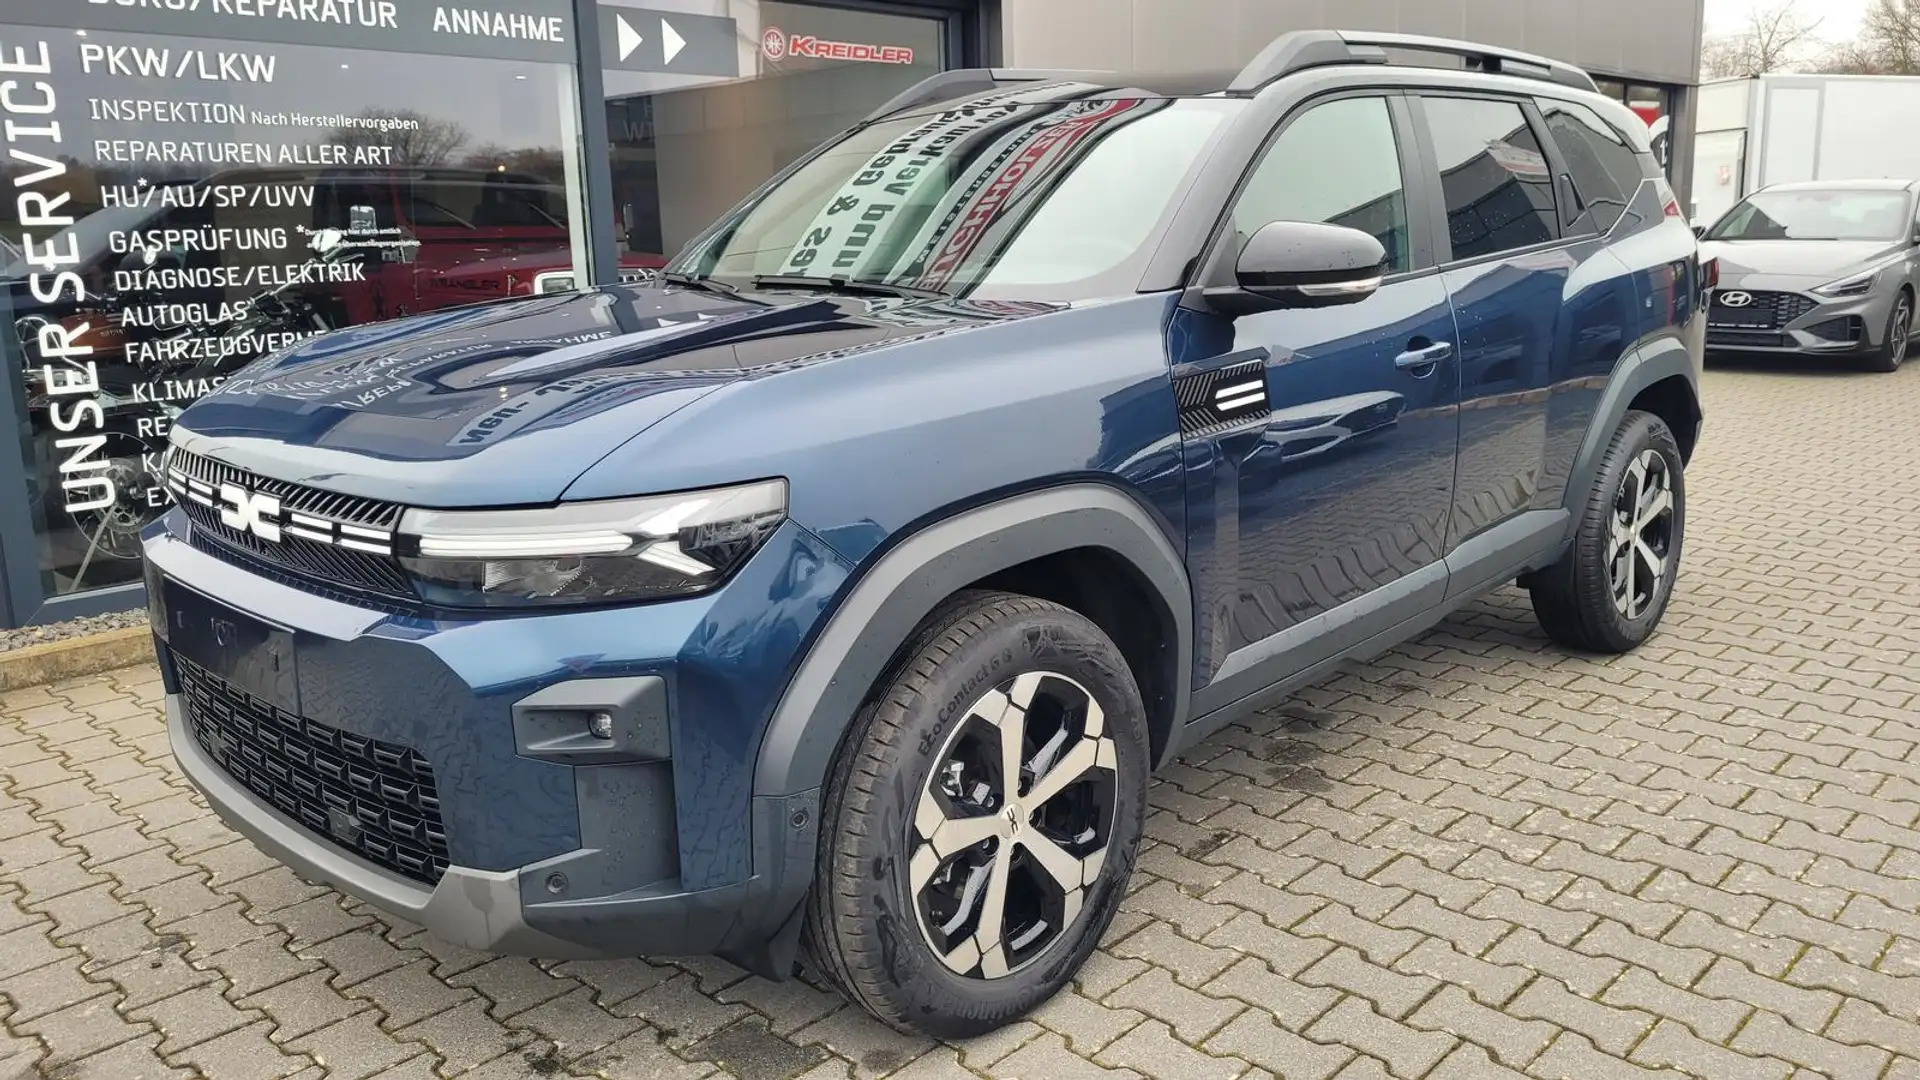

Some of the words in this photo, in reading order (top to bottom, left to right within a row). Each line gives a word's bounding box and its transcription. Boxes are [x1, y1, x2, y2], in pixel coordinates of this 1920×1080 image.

[88, 0, 398, 28] REPARATUR
[433, 6, 564, 42] ANNAHME
[81, 43, 275, 82] PKW/LKW
[789, 34, 914, 64] KREIDLER
[88, 98, 245, 124] INSPEKTION
[251, 111, 288, 126] Nach
[291, 113, 418, 132] Herstellervorgaben
[95, 140, 272, 163] REPARATUREN
[278, 144, 348, 164] ALLER
[354, 146, 392, 165] ART
[0, 41, 86, 304] SERVICE
[109, 224, 287, 253] GASPRÜFUNG
[114, 262, 366, 291] DIAGNOSE/ELEKTRIK
[121, 300, 248, 327] AUTOGLAS
[125, 330, 327, 363] FAHRZEUGVER
[132, 376, 231, 402] KLIMAS
[39, 322, 117, 514] UNSER
